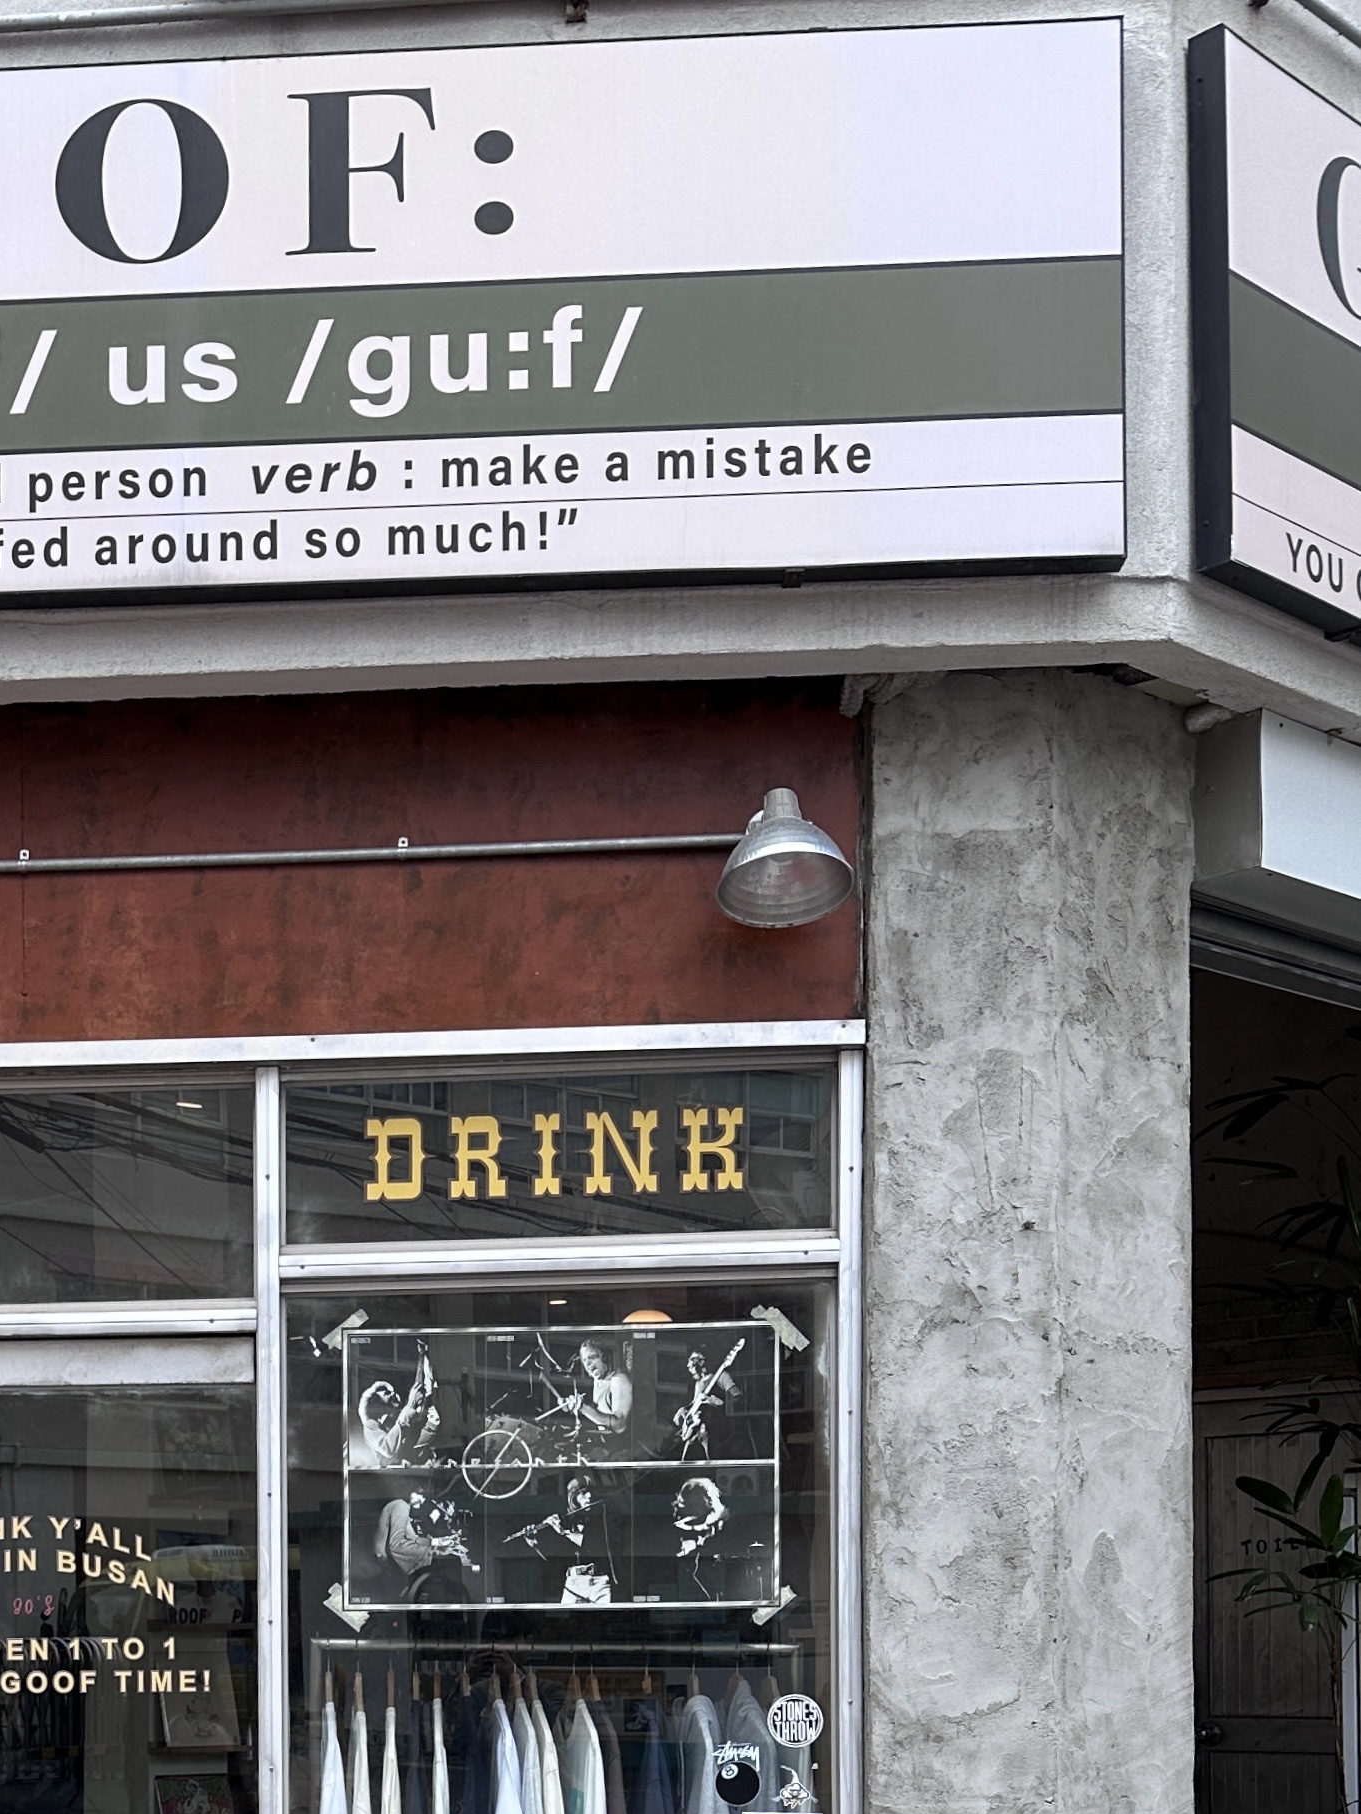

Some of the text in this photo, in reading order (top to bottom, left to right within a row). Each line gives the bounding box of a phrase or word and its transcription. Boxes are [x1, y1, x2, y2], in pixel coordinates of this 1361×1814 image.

[108, 342, 238, 406] us
[285, 304, 644, 418] /gu:f/
[28, 467, 206, 514] person
[251, 449, 377, 495] verb
[441, 443, 579, 488] make
[605, 451, 629, 483] a
[657, 433, 871, 481] mistake
[94, 519, 278, 566] around
[305, 527, 361, 559] so
[1285, 532, 1343, 594] YOU
[366, 1107, 744, 1201] DRINK
[4, 1549, 37, 1573] IN
[57, 1549, 174, 1606] BUSAN
[69, 1637, 80, 1660] 1
[101, 1637, 145, 1661] TO
[163, 1637, 175, 1660] 1
[0, 1670, 96, 1694] GOOF
[114, 1670, 210, 1693] TIME!
[773, 1700, 818, 1722] STONES
[774, 1720, 817, 1742] THROW
